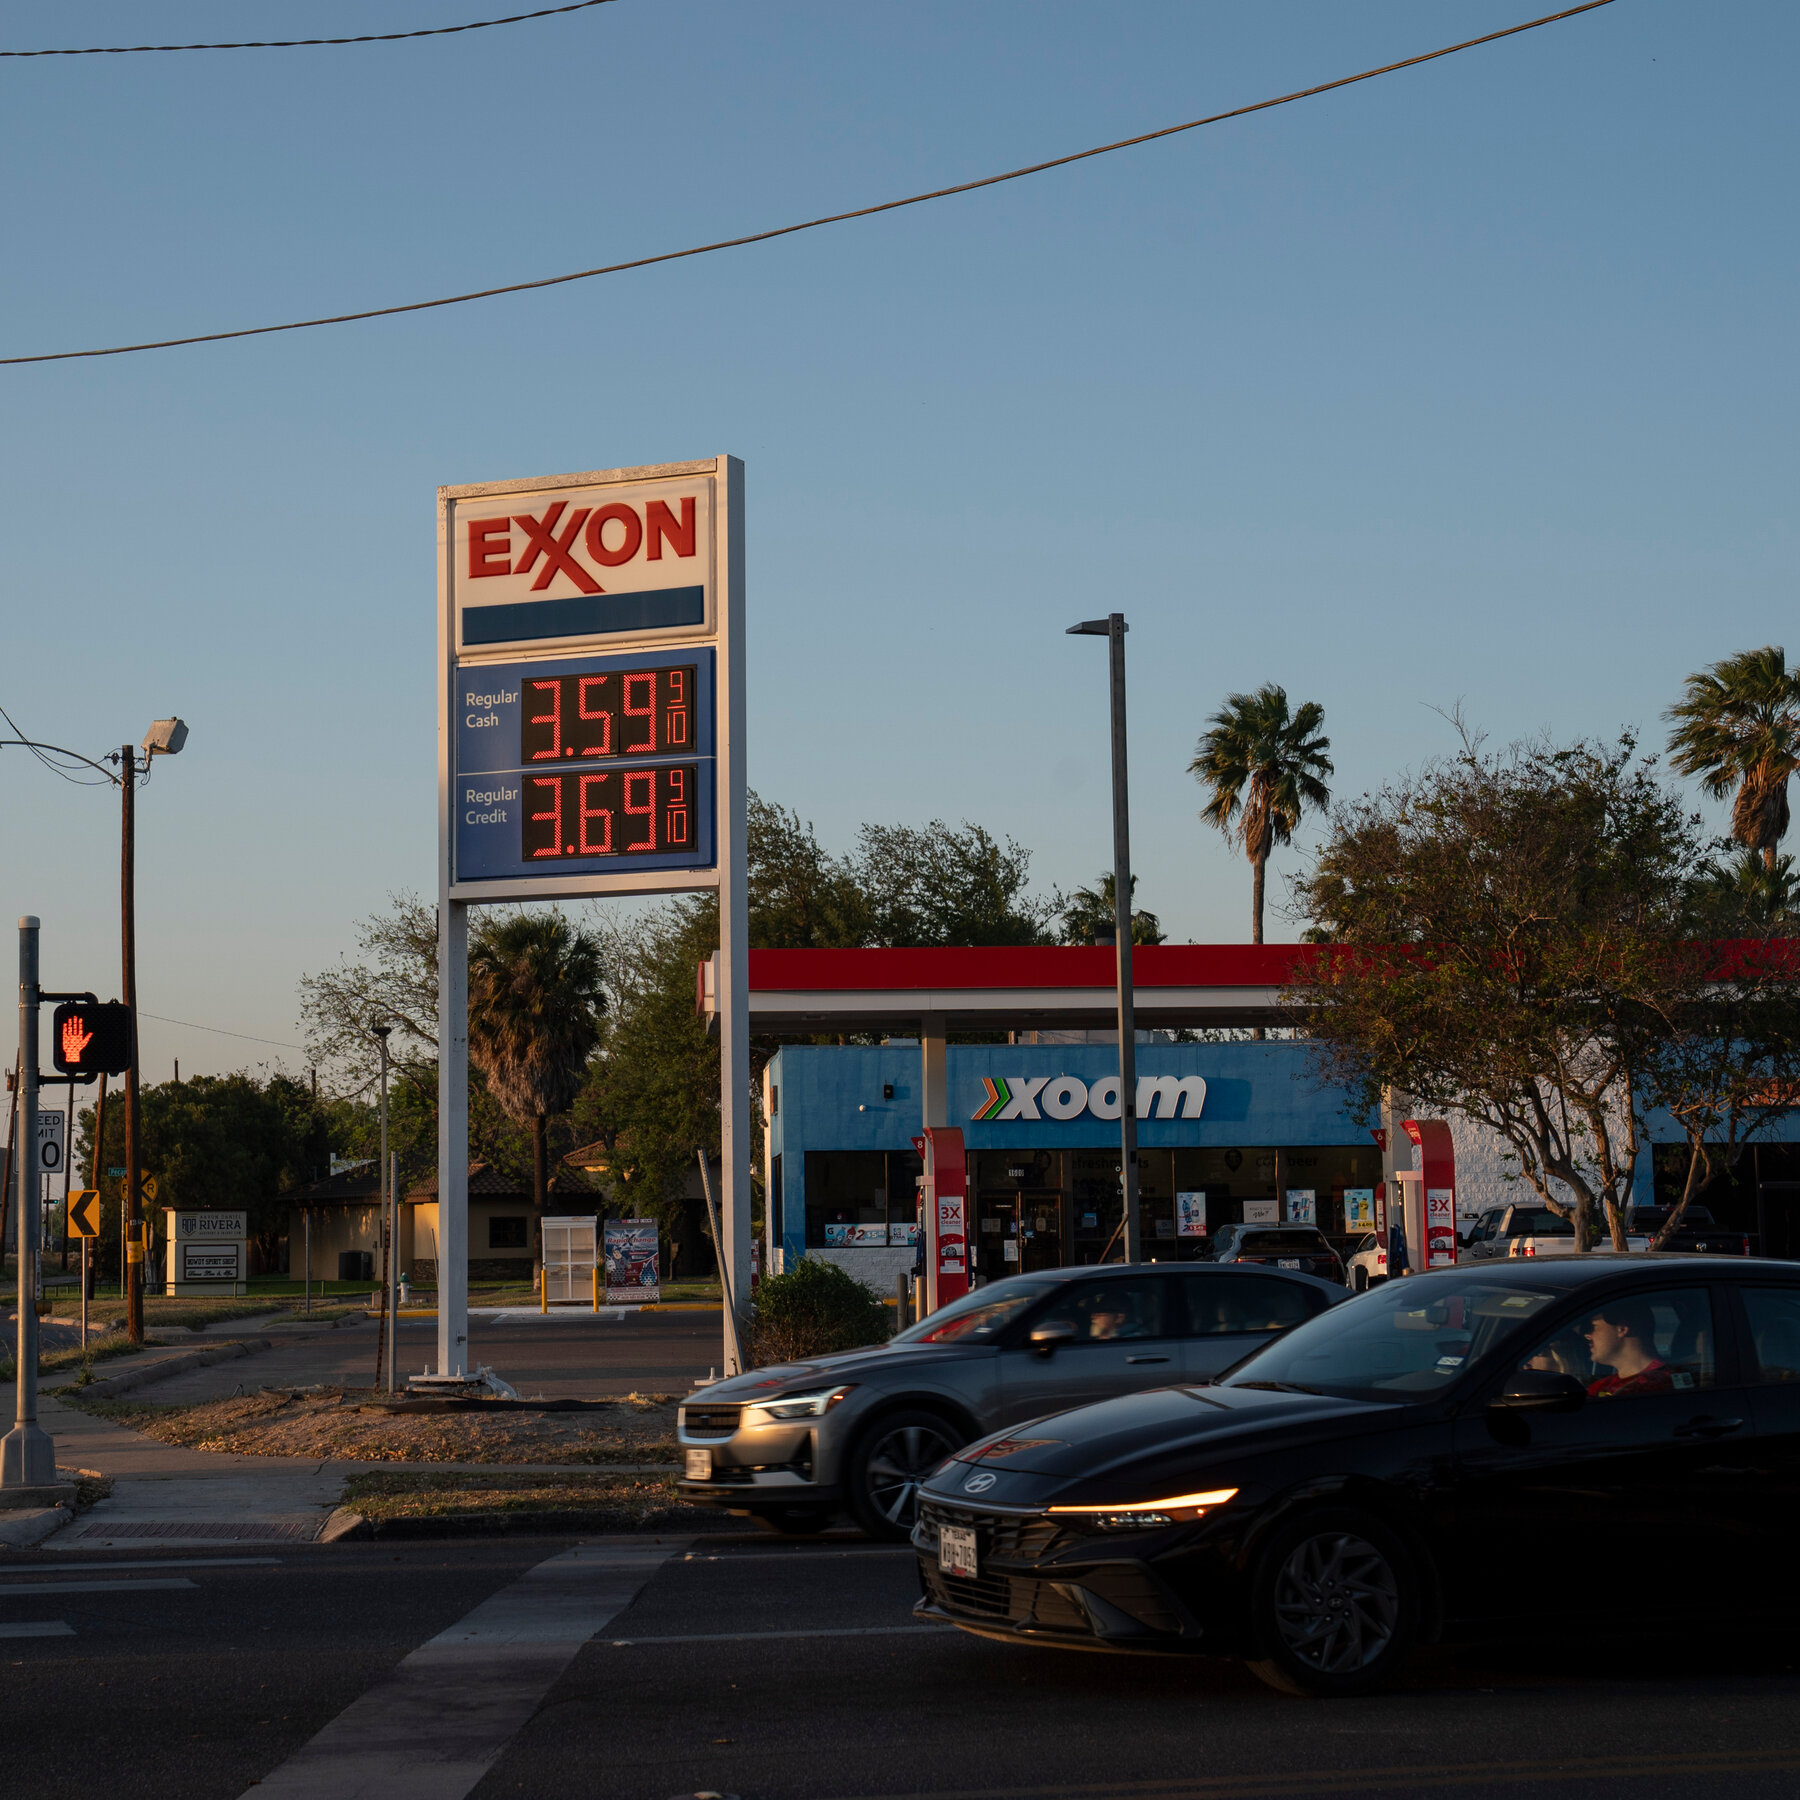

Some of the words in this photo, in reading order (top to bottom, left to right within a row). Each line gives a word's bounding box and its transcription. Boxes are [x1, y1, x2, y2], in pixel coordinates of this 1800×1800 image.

[468, 497, 696, 594] EXXON
[466, 689, 518, 709] Regular
[466, 712, 499, 729] Cash
[531, 672, 656, 759] 3.59
[466, 786, 518, 806] Regular
[466, 809, 507, 825] Credit
[531, 770, 656, 857] 3.69
[1377, 1131, 1383, 1141] 6
[917, 1140, 923, 1149] 8
[42, 1141, 60, 1168] 0
[147, 1184, 154, 1192] R
[941, 1206, 961, 1220] 3X
[1429, 1199, 1450, 1212] 3X
[199, 1219, 241, 1230] RIVERA
[856, 1229, 866, 1240] 2
